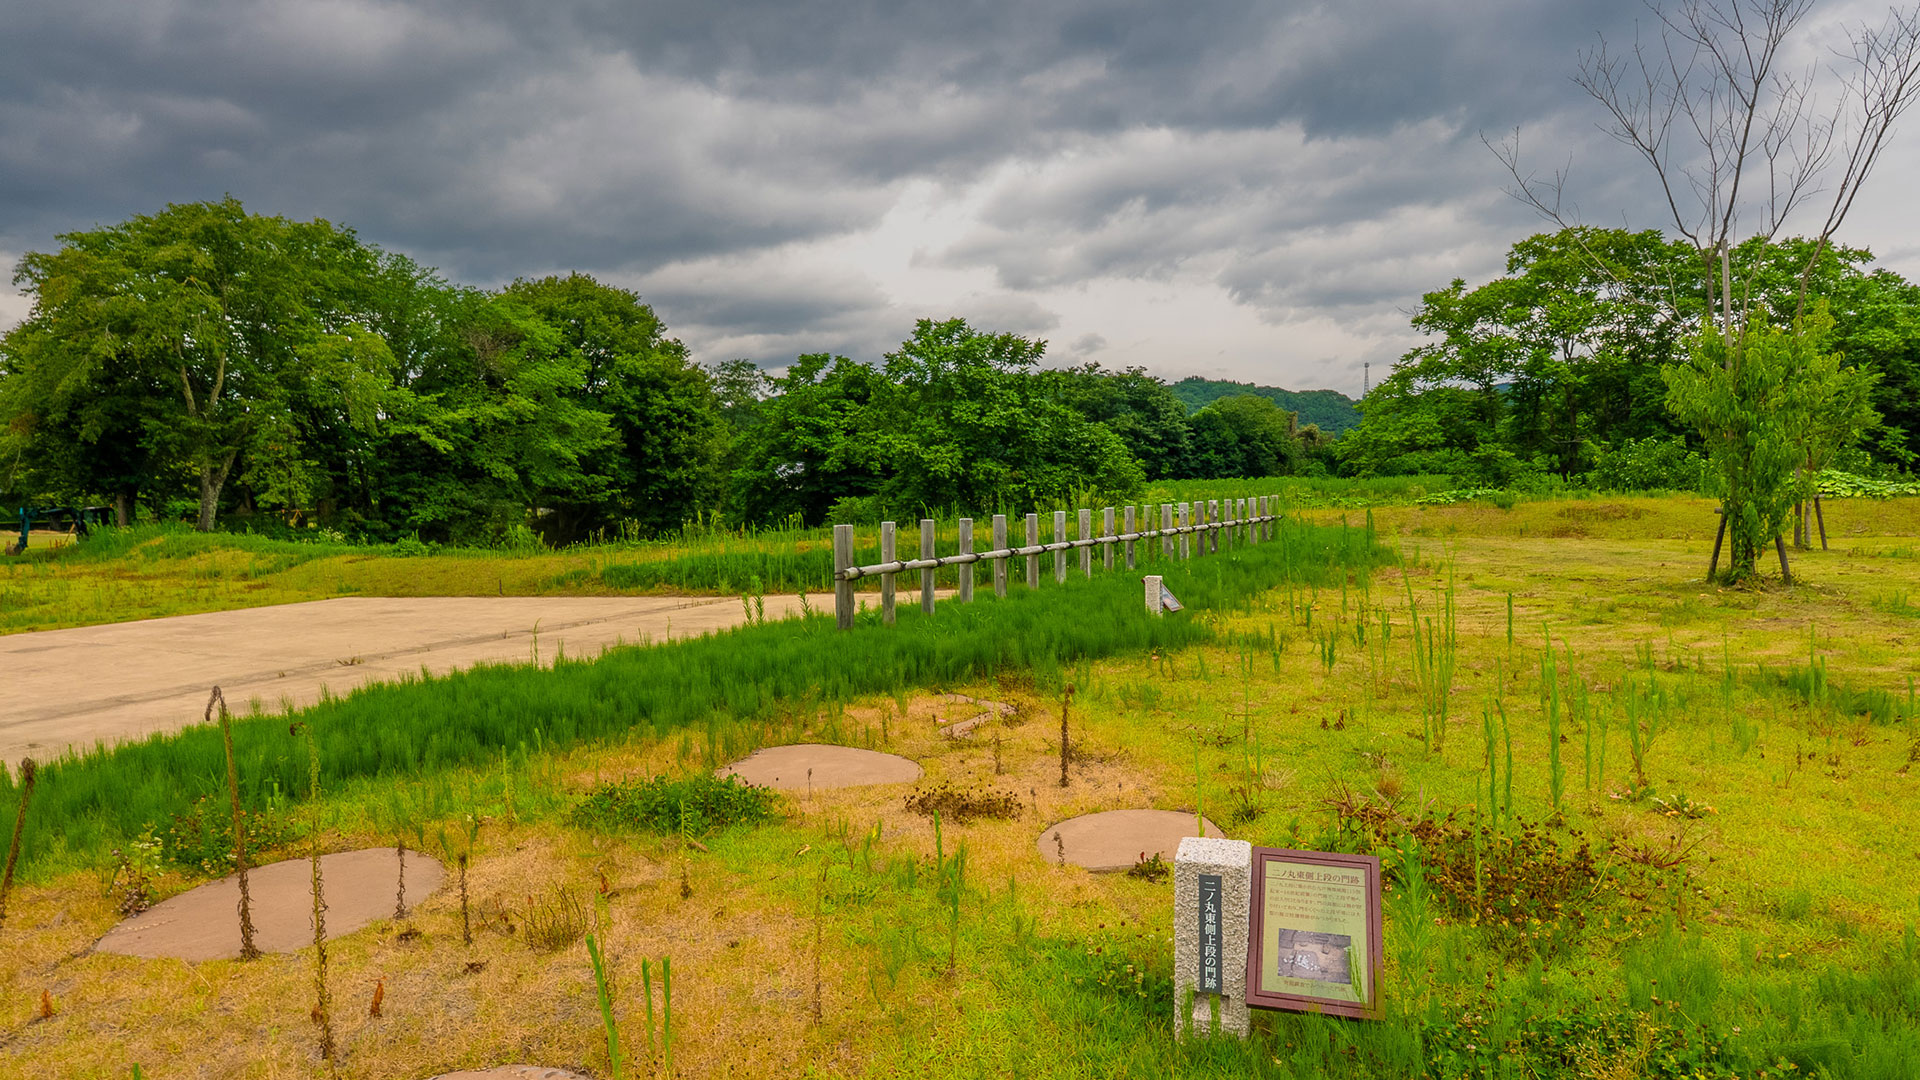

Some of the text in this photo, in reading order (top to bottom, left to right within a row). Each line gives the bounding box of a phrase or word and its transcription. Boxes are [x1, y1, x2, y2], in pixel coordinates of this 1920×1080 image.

[1272, 869, 1360, 884] 二ノ丸東側上段の門跡
[1204, 881, 1217, 990] 二ノ丸東側上段の門跡
